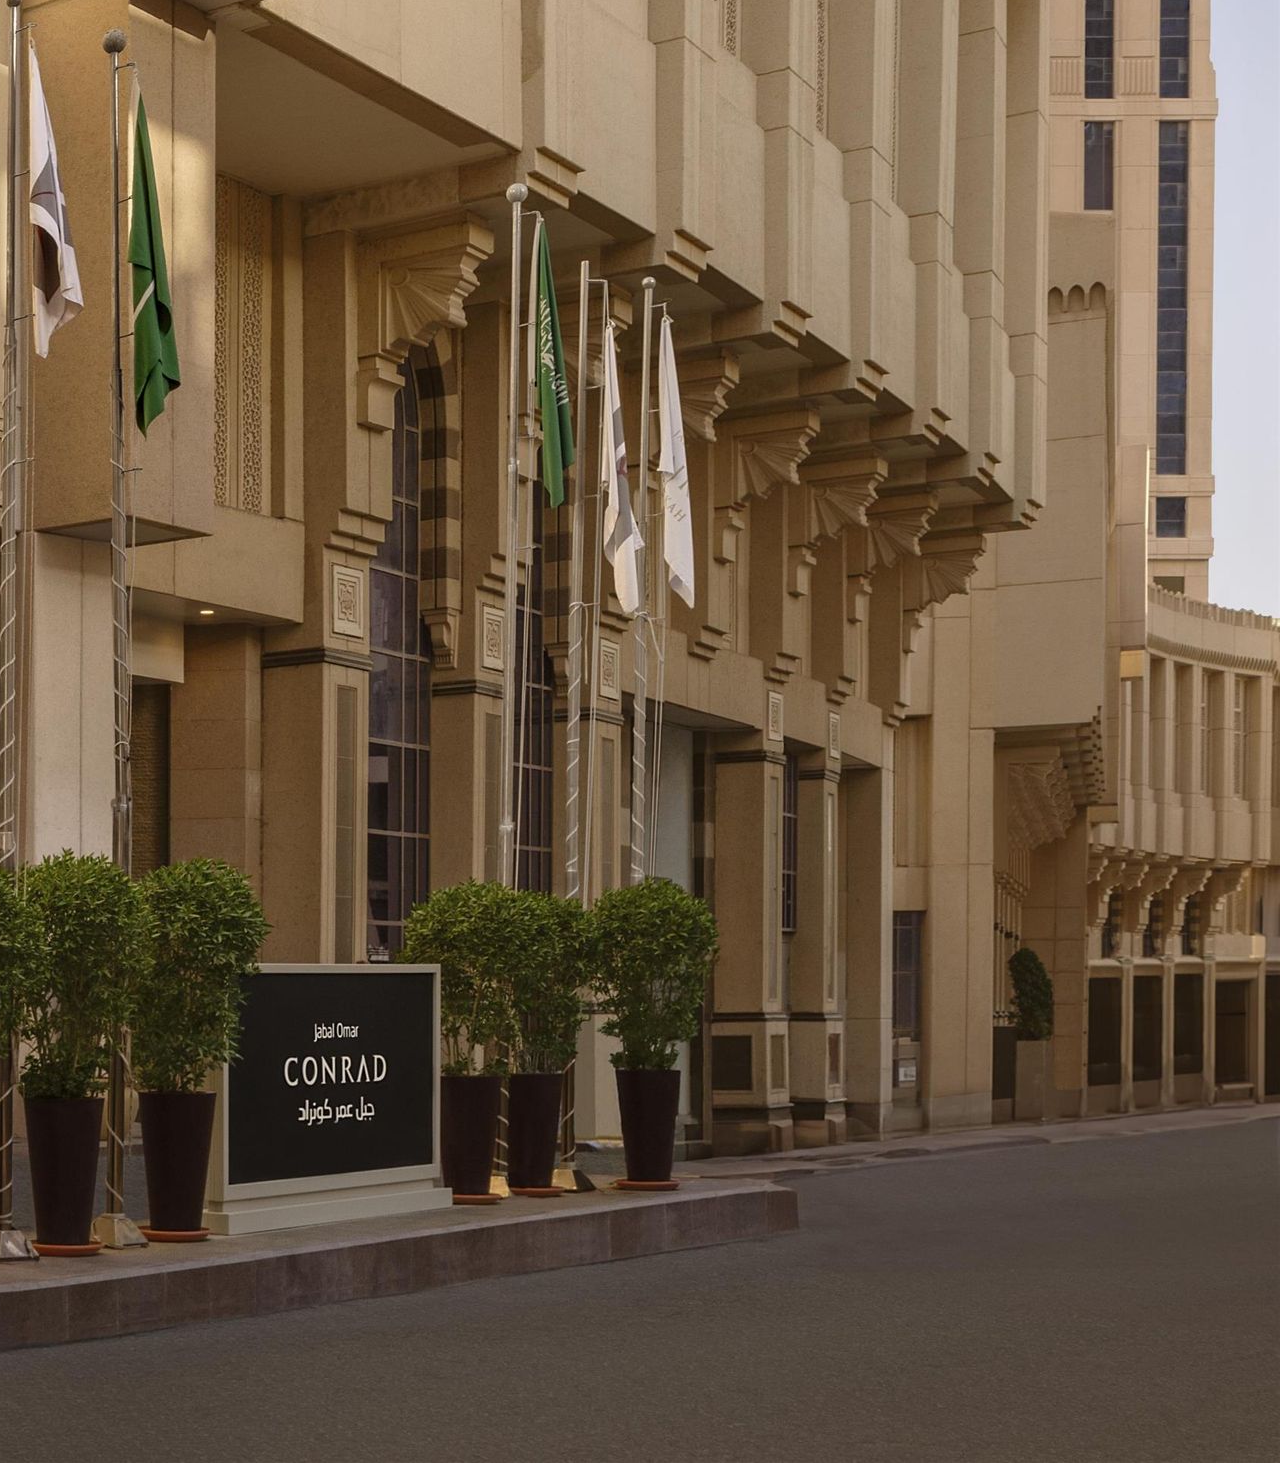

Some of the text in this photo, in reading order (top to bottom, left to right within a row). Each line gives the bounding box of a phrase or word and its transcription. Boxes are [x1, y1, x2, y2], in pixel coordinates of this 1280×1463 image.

[313, 1022, 360, 1043] Jabal Omar
[283, 1053, 388, 1087] CONRAD
[297, 1096, 375, 1126] جبل عمر كونراد
